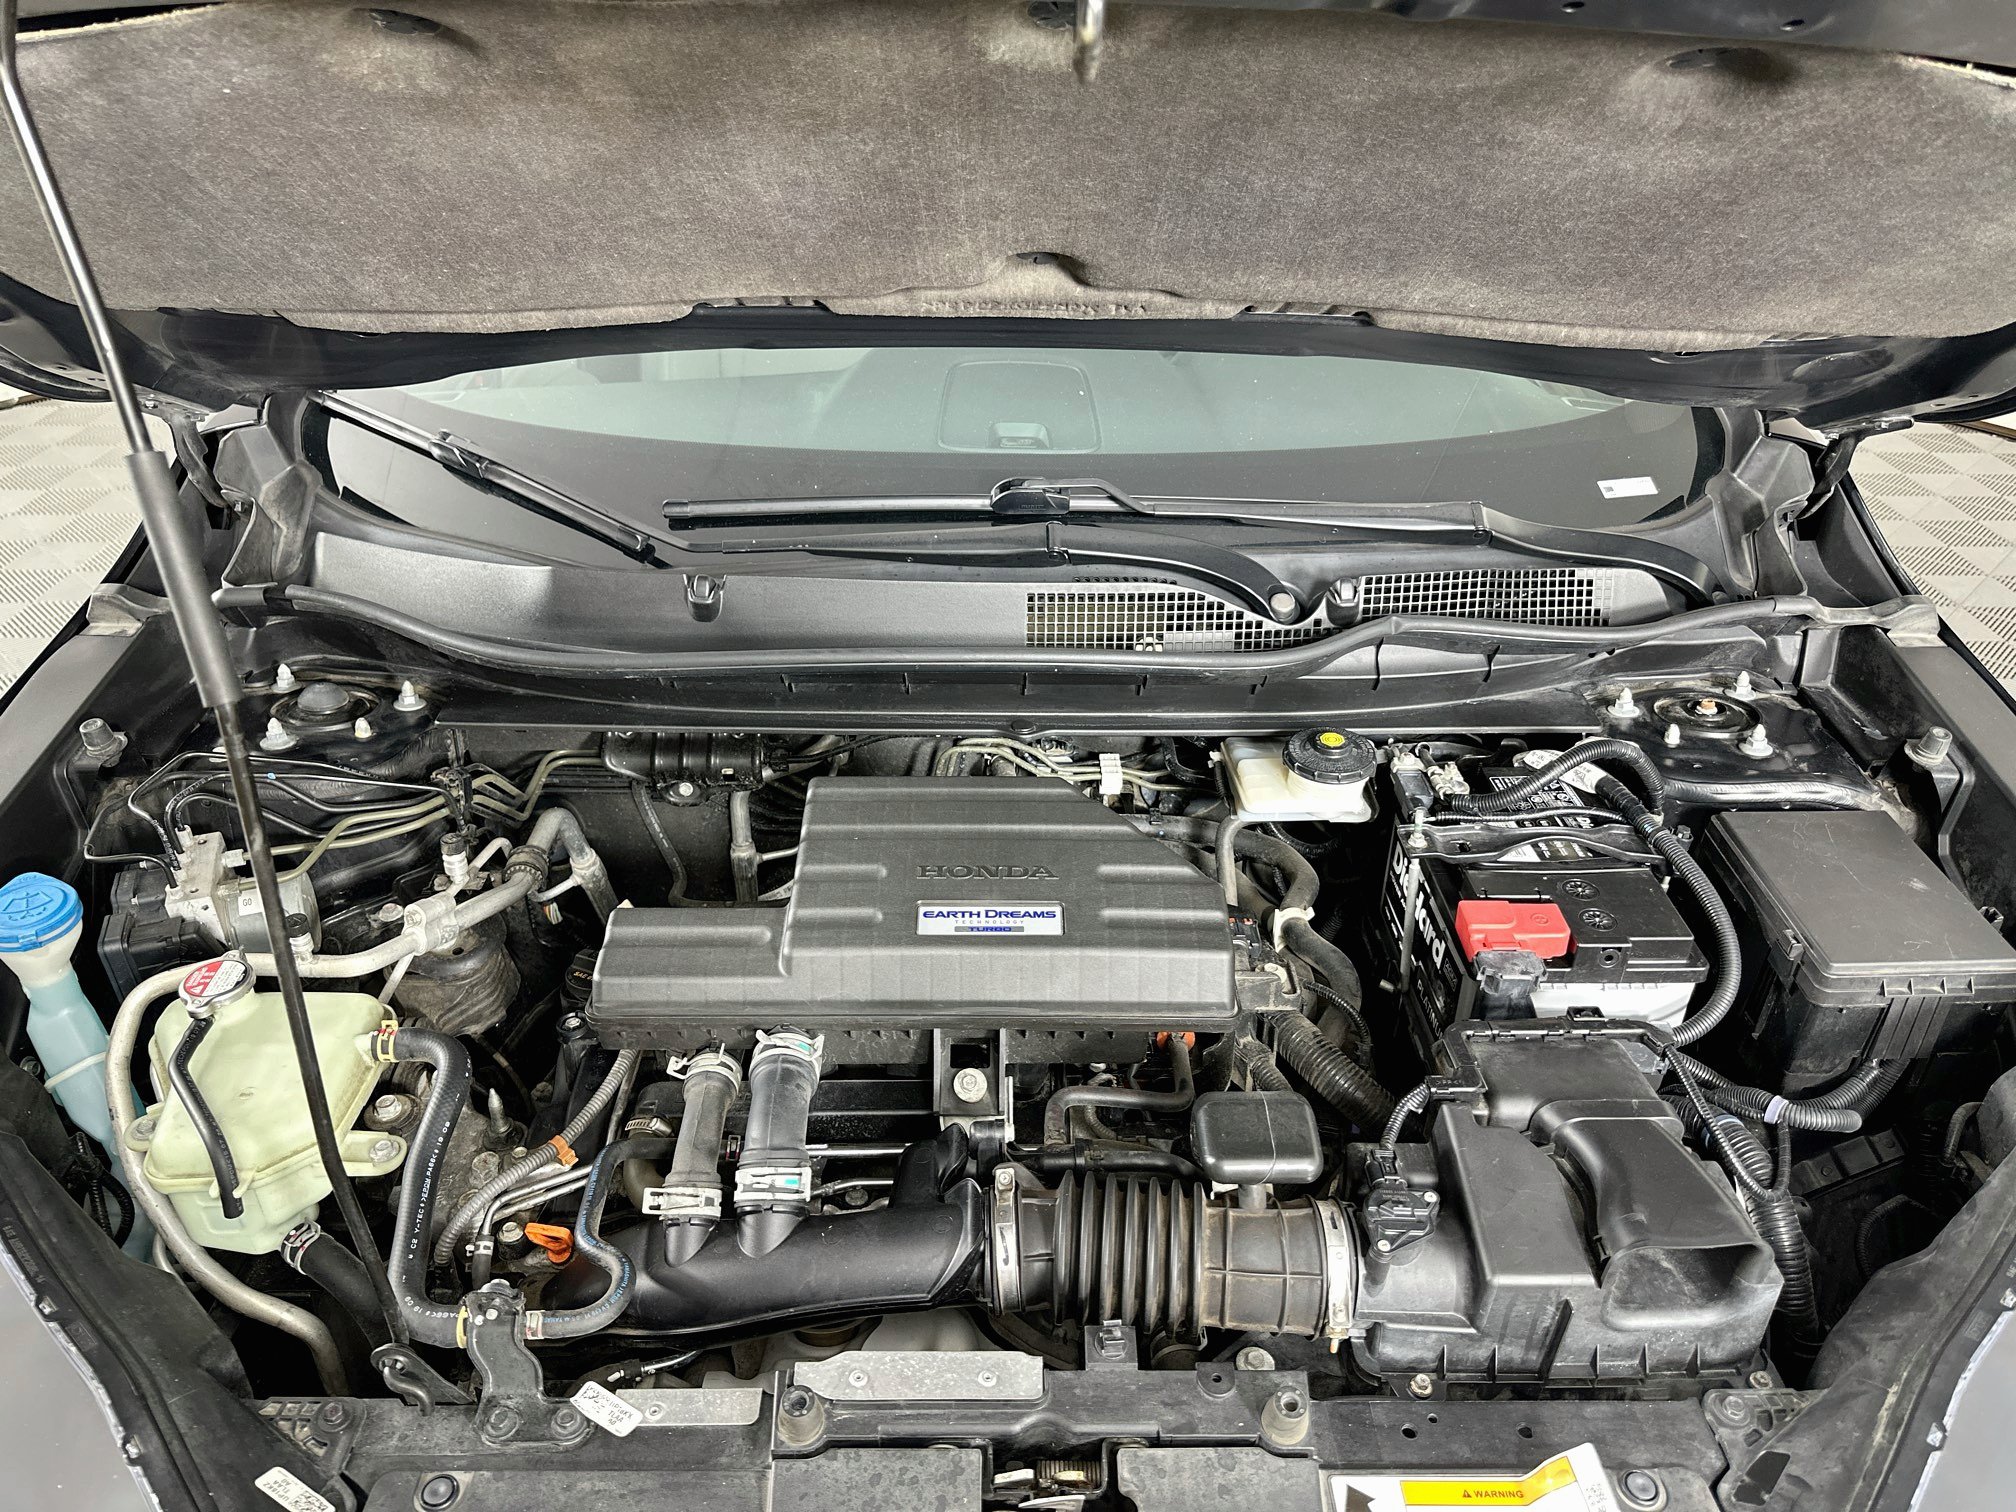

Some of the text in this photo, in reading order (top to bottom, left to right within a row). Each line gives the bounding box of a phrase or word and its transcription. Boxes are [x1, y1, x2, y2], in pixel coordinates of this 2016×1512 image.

[917, 865, 1060, 880] HONDA
[922, 909, 1057, 919] EARTH DREAMS
[1473, 1490, 1524, 1499] WARNING
